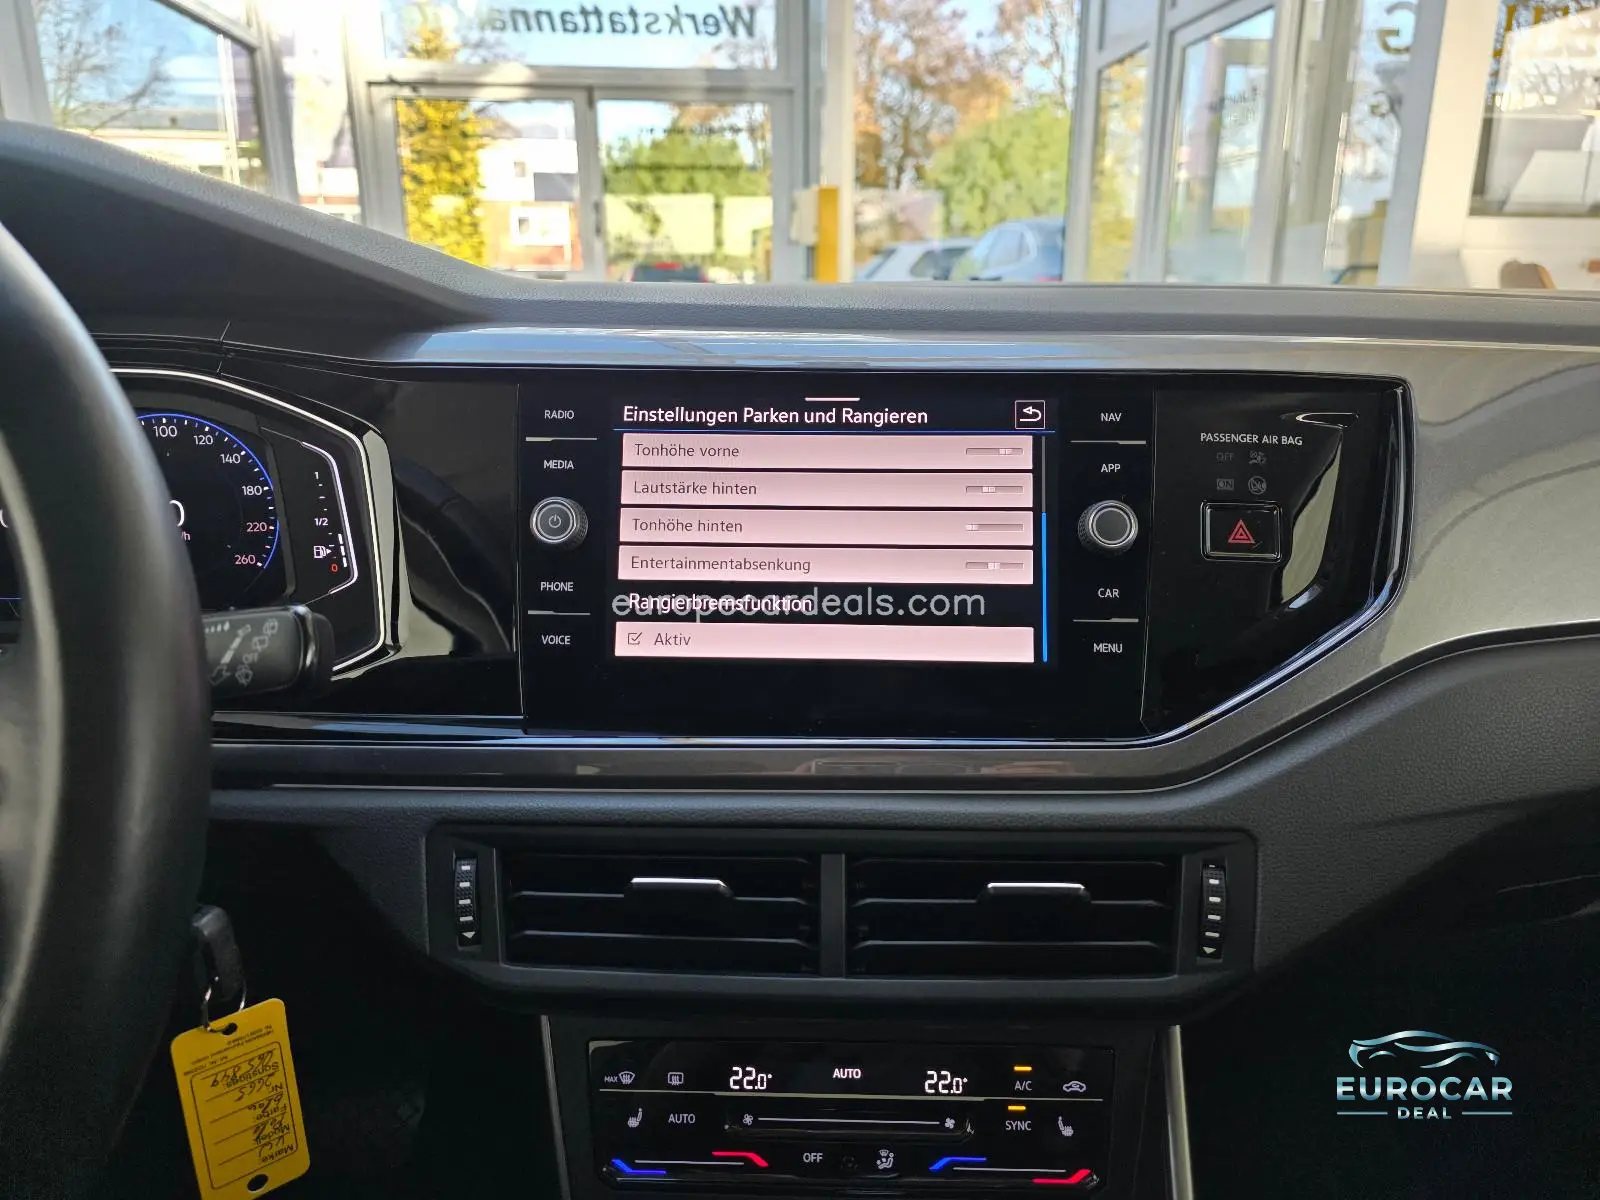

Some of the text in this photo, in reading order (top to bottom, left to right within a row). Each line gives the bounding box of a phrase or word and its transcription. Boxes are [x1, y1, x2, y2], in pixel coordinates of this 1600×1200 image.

[544, 409, 575, 420] RADIO
[624, 406, 927, 427] Einstellungen Parken und Rangieren
[1100, 412, 1122, 422] NAV
[153, 425, 178, 438] 100
[193, 433, 214, 446] 120
[1200, 432, 1303, 446] PASSENGER AIR BAG
[634, 443, 740, 457] Tonhöhe vorne
[219, 453, 241, 464] 140
[543, 459, 575, 470] MEDIA
[1100, 463, 1121, 473] APP
[241, 485, 263, 496] 180
[634, 480, 757, 495] Lautstärke hinten
[246, 521, 268, 533] 220
[314, 517, 329, 527] 1/2
[632, 518, 743, 533] Tonhöhe hinten
[234, 554, 256, 565] 260
[632, 556, 810, 574] Entertainmentabsenkung
[331, 563, 338, 573] 0
[540, 581, 574, 592] PHONE
[1097, 587, 1120, 599] CAR
[629, 593, 812, 615] Rangierbremsfunktion
[541, 634, 571, 645] VOICE
[653, 632, 691, 646] Aktiv
[1093, 642, 1123, 654] MENU
[832, 1067, 862, 1079] AUTO
[603, 1075, 618, 1083] MAX
[1014, 1080, 1033, 1091] A/C
[667, 1113, 696, 1124] AUTO
[1005, 1119, 1032, 1131] SYNC
[802, 1152, 824, 1163] OFF
